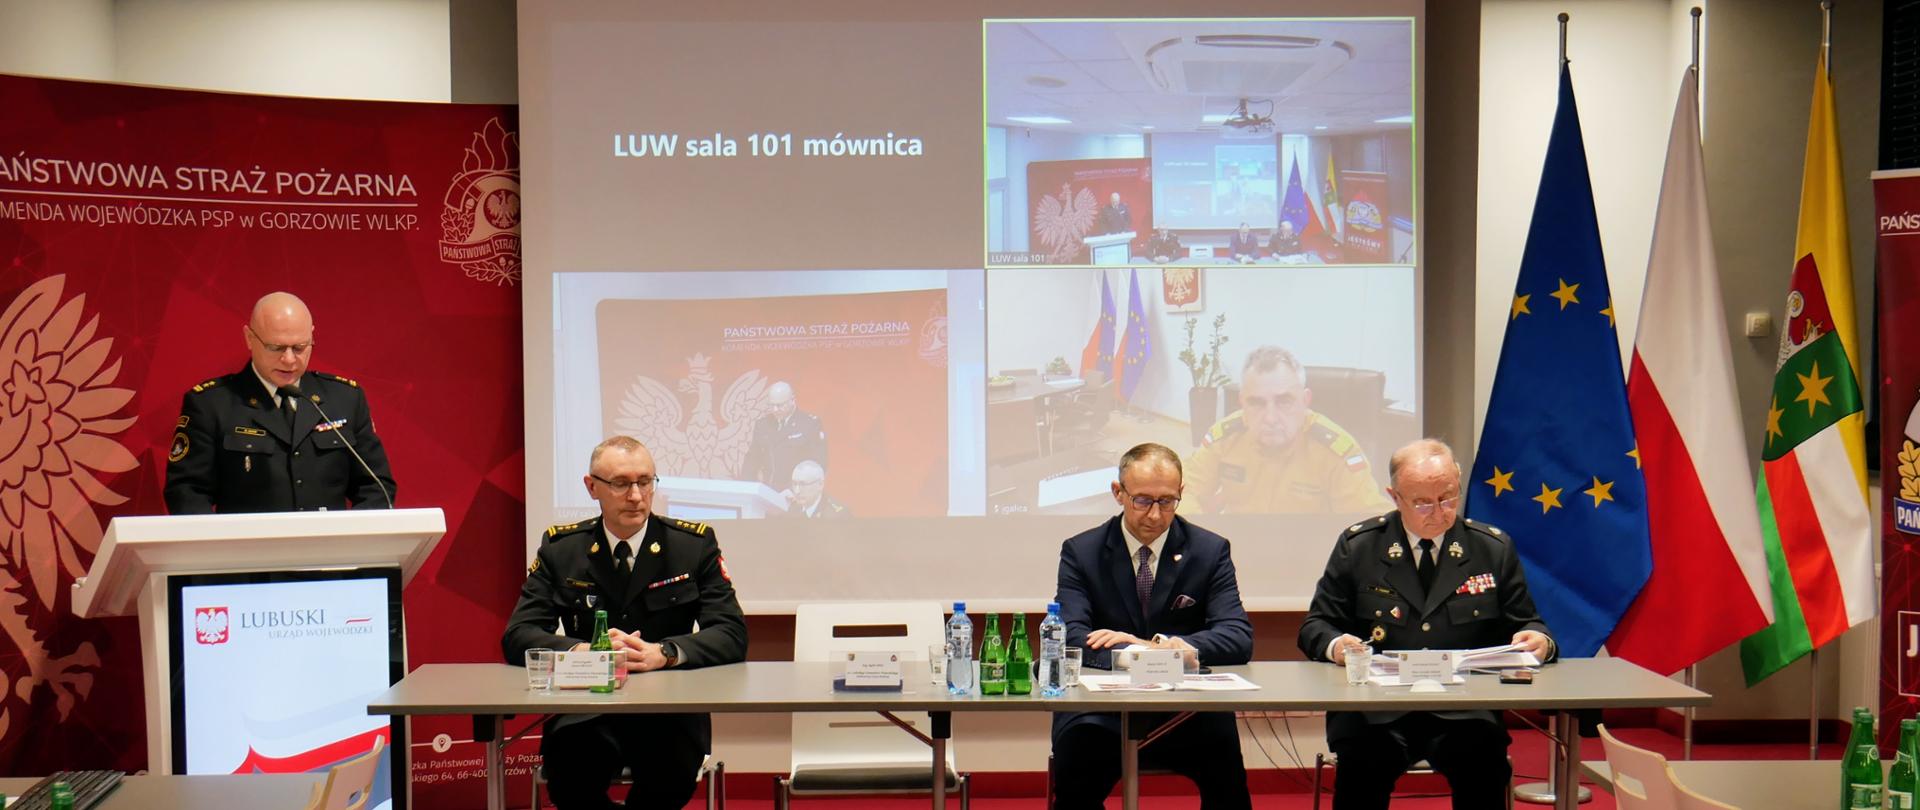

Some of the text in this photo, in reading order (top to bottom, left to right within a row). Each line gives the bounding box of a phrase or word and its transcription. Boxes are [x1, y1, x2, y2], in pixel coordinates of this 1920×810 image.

[613, 132, 923, 157] LUW sala 101 mównica
[176, 165, 268, 194] STRAŻ
[276, 168, 417, 197] POŻARNA
[68, 203, 197, 227] WOJEWÓDZKA
[201, 210, 234, 228] PSP
[239, 215, 254, 228] w
[260, 212, 361, 230] GORZOWIE
[366, 214, 420, 231] WLKP.
[1880, 211, 1920, 230] PAŃS
[443, 245, 492, 259] PAŃSTWOWA
[724, 320, 910, 338] PAŃSTWOWA STRAŻ POŻARNA
[241, 609, 325, 629] LUBUSKI
[268, 629, 303, 640] URZĄD
[430, 756, 484, 769] Państwowej
